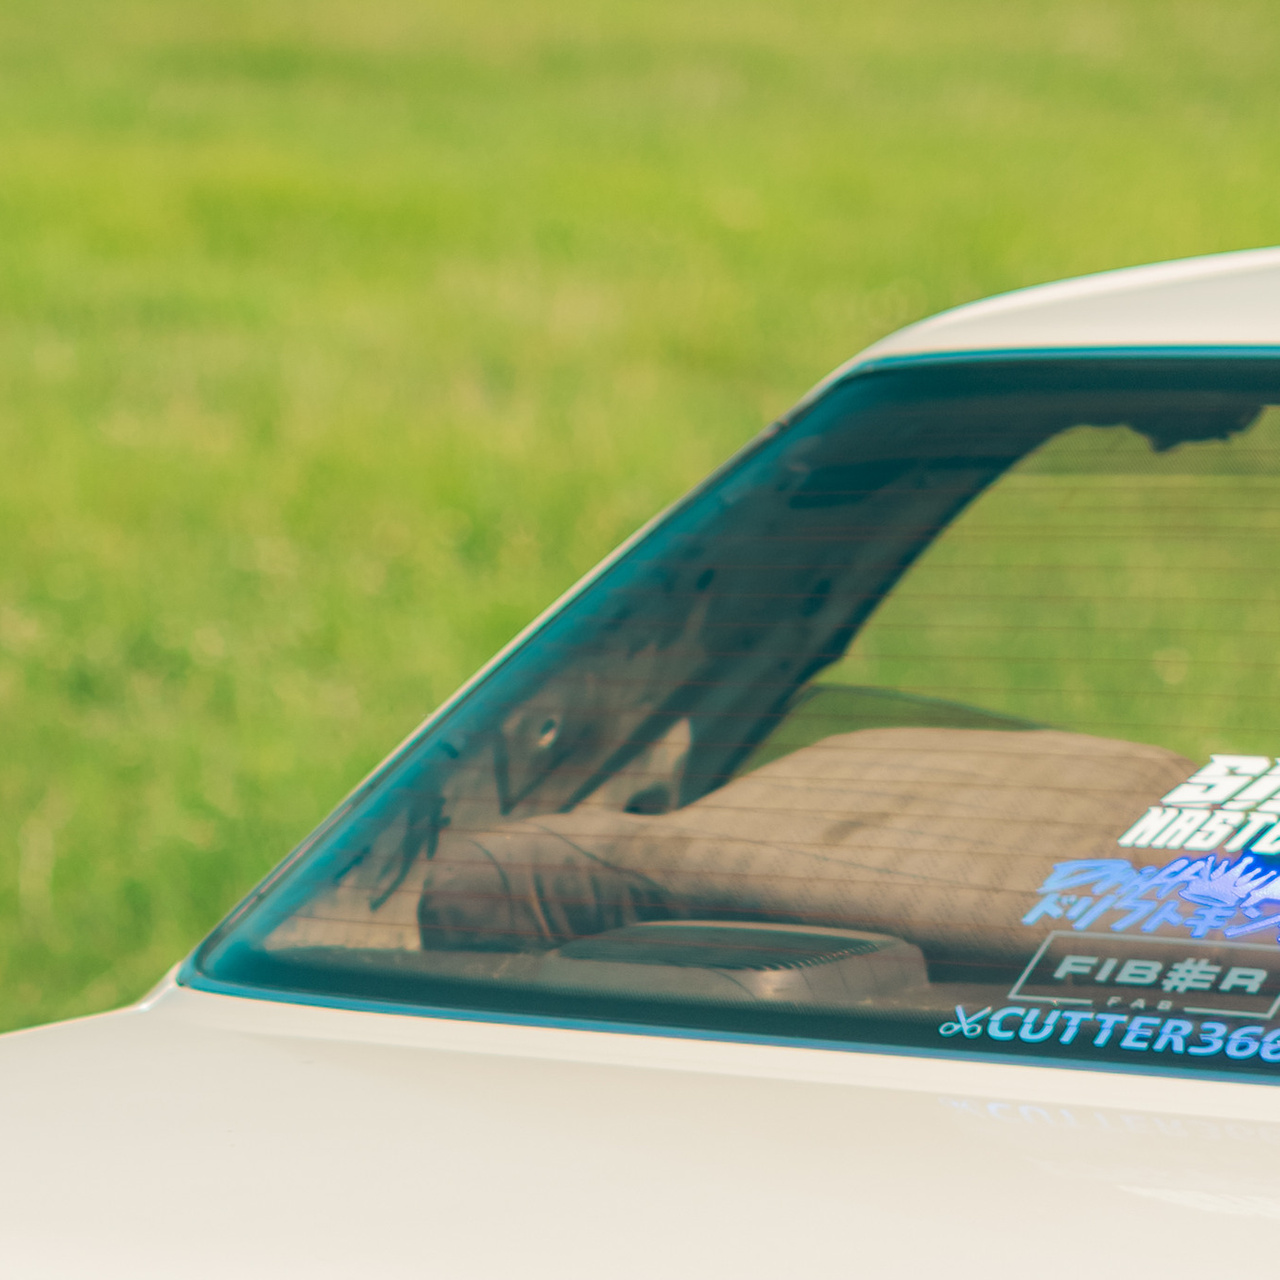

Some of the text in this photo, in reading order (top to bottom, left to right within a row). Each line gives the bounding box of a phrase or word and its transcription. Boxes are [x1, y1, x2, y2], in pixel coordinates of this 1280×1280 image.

[1022, 893, 1280, 940] ドリフトキン
[1107, 995, 1172, 1011] FAB
